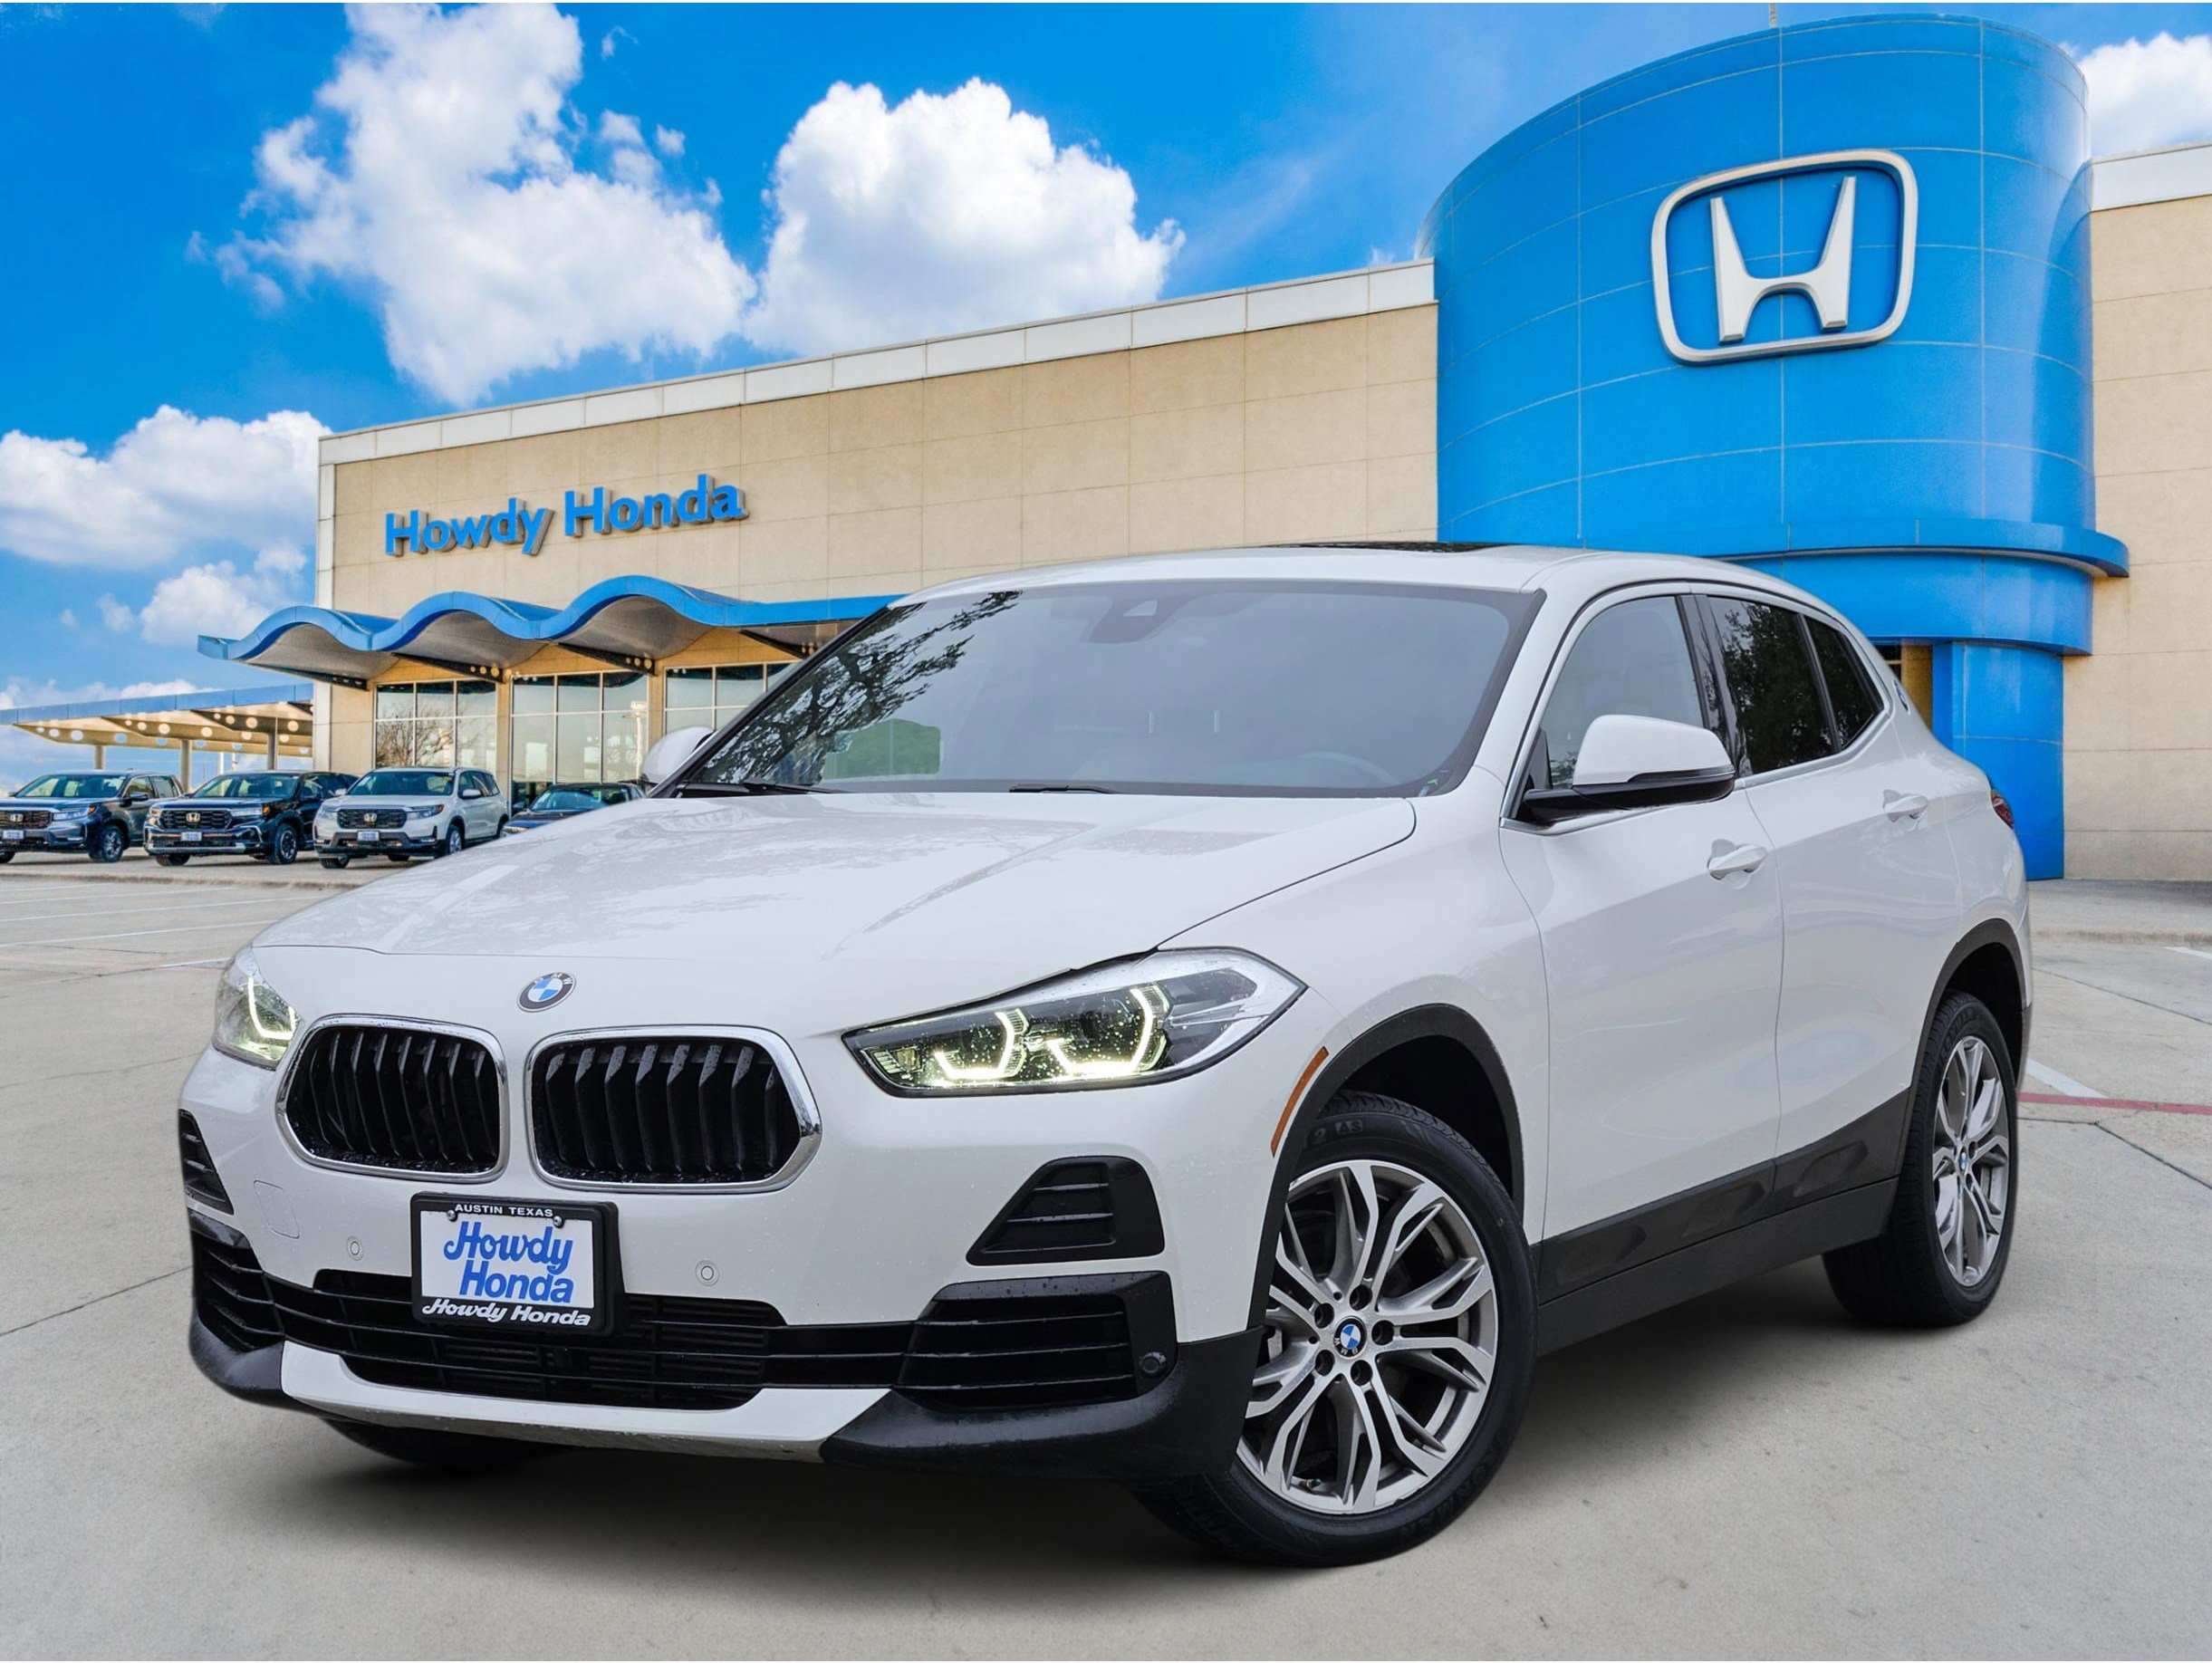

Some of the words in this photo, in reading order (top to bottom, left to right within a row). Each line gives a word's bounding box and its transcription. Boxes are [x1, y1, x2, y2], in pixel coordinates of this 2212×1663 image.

[386, 497, 554, 557] Howdy
[564, 474, 749, 537] Honda
[455, 1204, 504, 1215] AUSTIN
[508, 1206, 553, 1218] TEXAS
[444, 1221, 573, 1274] Howdy
[459, 1259, 574, 1303] Honda
[422, 1298, 507, 1323] Howdy
[510, 1305, 591, 1326] Honda
